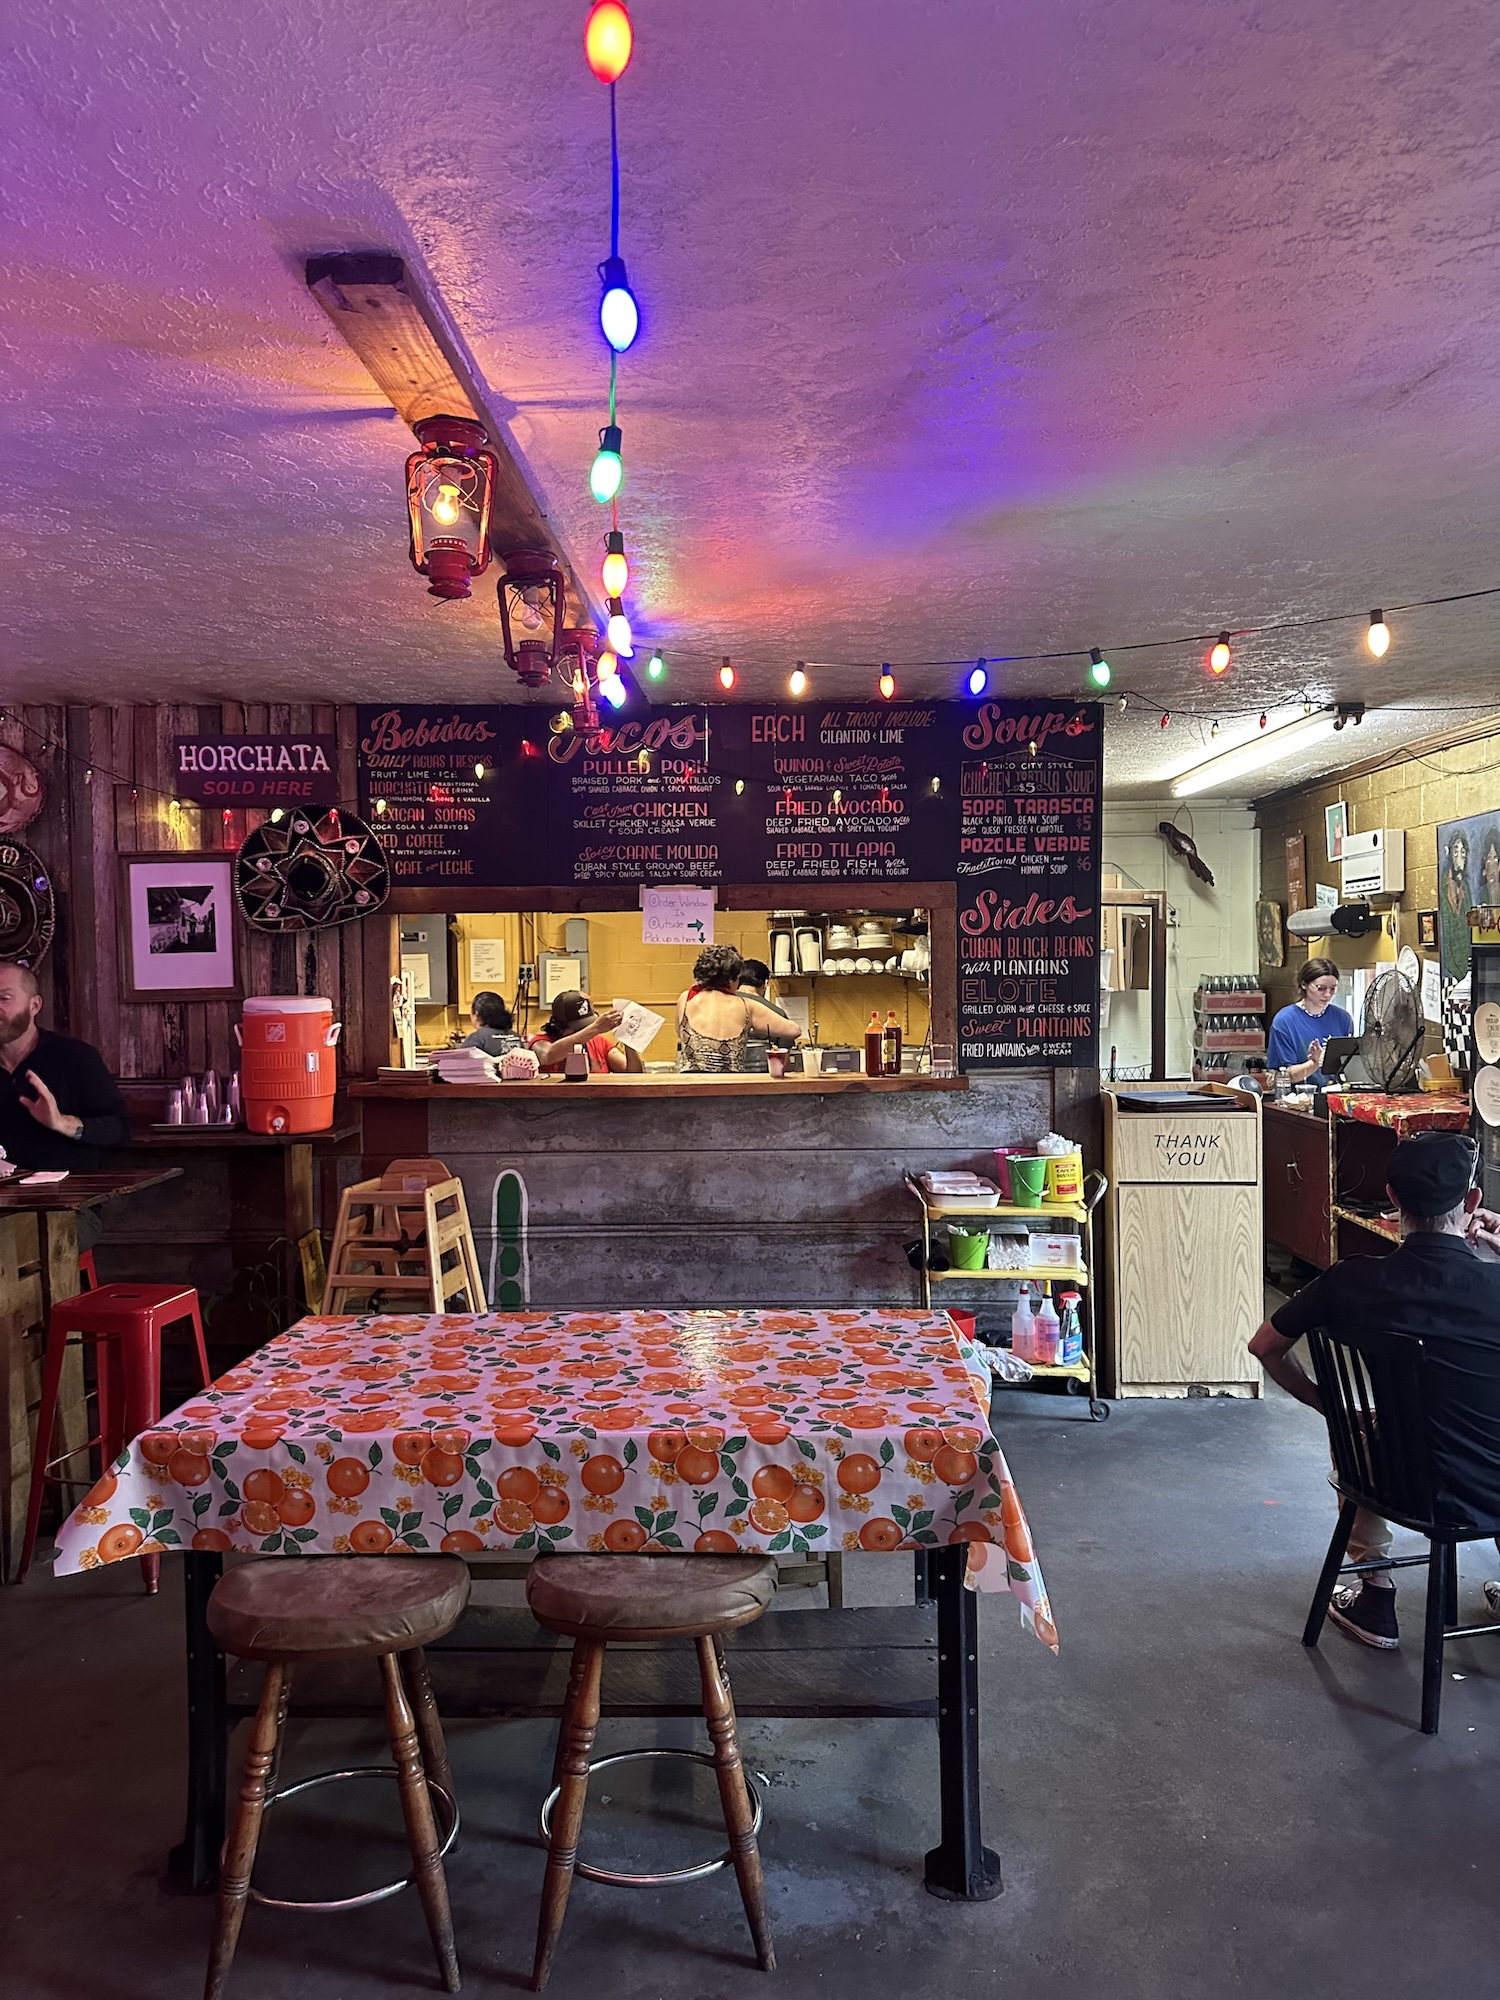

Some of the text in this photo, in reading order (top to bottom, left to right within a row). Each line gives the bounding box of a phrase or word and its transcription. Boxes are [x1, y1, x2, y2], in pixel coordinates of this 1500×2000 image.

[820, 710, 937, 728] ALL TACOS INCLUDE:
[361, 709, 497, 754] Bebidas
[752, 715, 805, 743] EACH
[963, 703, 1095, 751] Soups
[820, 729, 905, 744] CILANTRO LIME
[179, 744, 330, 772] HORCHATA
[366, 753, 411, 768] DAILY
[413, 755, 446, 768] AGUAS
[774, 758, 824, 775] QUINOA
[833, 755, 868, 774] Sweet
[862, 755, 905, 774] Potato
[583, 759, 709, 775] PULLED PORK
[1021, 762, 1043, 770] CITY
[572, 777, 609, 785] BRAISED
[615, 776, 642, 785] PORK
[663, 776, 721, 785] TOMATILLOS
[782, 773, 878, 784] VEGETARIAN TACO
[963, 769, 1094, 794] CHICKEN TORTILLA SOUP
[203, 781, 313, 795] SOLD HERE
[369, 781, 433, 794] HORCHATA
[667, 785, 686, 793] SPICY
[688, 785, 713, 793] YOGURT
[767, 783, 908, 792] SOUR SALSA
[1018, 782, 1036, 793] $5
[584, 802, 610, 818] Cast
[632, 802, 708, 818] CHICKEN
[776, 799, 904, 816] FRIED AVOCADO
[962, 798, 1094, 815] SOPA TARASCA
[371, 808, 476, 822] MEXICAN SODAS
[766, 816, 891, 827] DEEP FRIED AVOCADO
[962, 815, 1060, 826] BLACK PINTO BEAN SOUP
[573, 818, 717, 828] SKILLET CHICKEN SALSA VERDE
[766, 826, 790, 834] SHAVED
[818, 826, 836, 834] ONION
[877, 825, 900, 833] YOGURT
[981, 824, 1064, 835] QUESO FRESCO CHIPOTLE
[1076, 815, 1092, 832] $5
[618, 827, 680, 835] SOUR CREAM
[406, 834, 445, 848] COFFEE
[960, 836, 1090, 853] POZOLE VERDE
[579, 844, 719, 861] Spicy CARNE MOLIDA
[776, 842, 896, 858] FRIED TILAPIA
[395, 860, 422, 875] CAFE
[440, 860, 474, 875] LECHE
[574, 861, 716, 871] CUBAN STYLE GROUND BEEF
[766, 859, 877, 869] DEEP FRIED FISH
[956, 855, 1017, 876] Traditional
[1020, 855, 1049, 864] CHICKEN
[1020, 864, 1068, 875] HOMINY SOUP
[1076, 855, 1092, 872] $6
[594, 869, 722, 879] SPICY ONIONS SALSA SOUR CREAM
[767, 869, 790, 877] SHAVED
[850, 868, 869, 876] SPICY
[871, 868, 883, 876] DILL
[886, 868, 910, 876] YOGURT
[649, 894, 708, 908] Order Window
[674, 908, 685, 917] Is
[960, 889, 1092, 935] Sides
[649, 916, 684, 929] Outside
[644, 931, 697, 944] Pick up here
[960, 936, 1094, 959] CUBAN BLACK BEANS
[993, 958, 1069, 975] PLANTAINS
[961, 978, 1057, 1003] ELOTE
[962, 1004, 1091, 1014] GRILLED CORN CHEESE SPICE
[961, 1016, 1091, 1038] Sweet PLANTAINS
[962, 1042, 983, 1058] FRIED
[986, 1042, 1026, 1058] PLANTAINS
[1155, 1135, 1221, 1148] THANK
[1166, 1152, 1206, 1166] YOU
